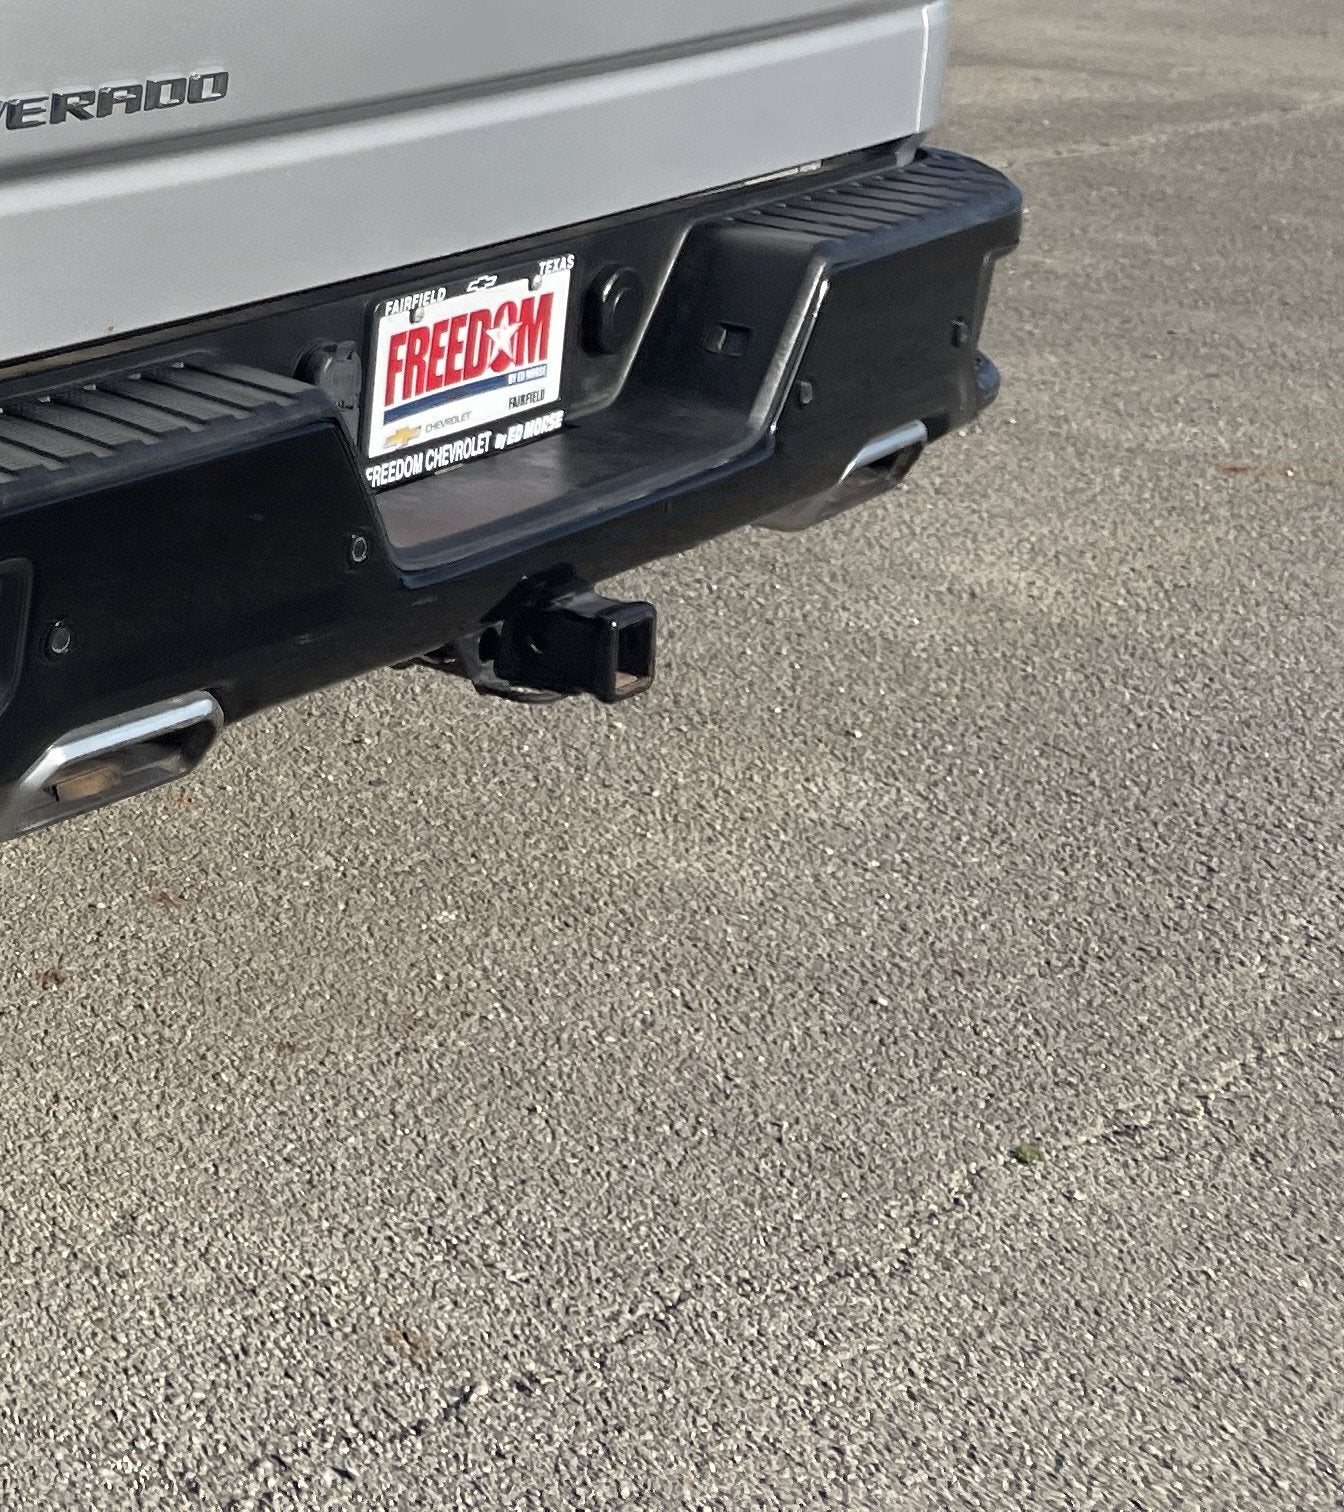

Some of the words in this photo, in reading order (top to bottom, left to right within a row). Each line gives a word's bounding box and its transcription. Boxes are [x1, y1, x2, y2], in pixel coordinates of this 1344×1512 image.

[539, 253, 575, 277] TEXAS
[385, 287, 447, 317] FAIRFIELD
[384, 292, 554, 407] FREEDOM
[508, 389, 545, 409] FAIRFIELD
[425, 411, 472, 433] CHEVROLET
[365, 451, 425, 488] FREEDOM
[424, 430, 492, 471] CHEVROLET
[506, 422, 524, 445] ED
[523, 409, 565, 440] MORSE
